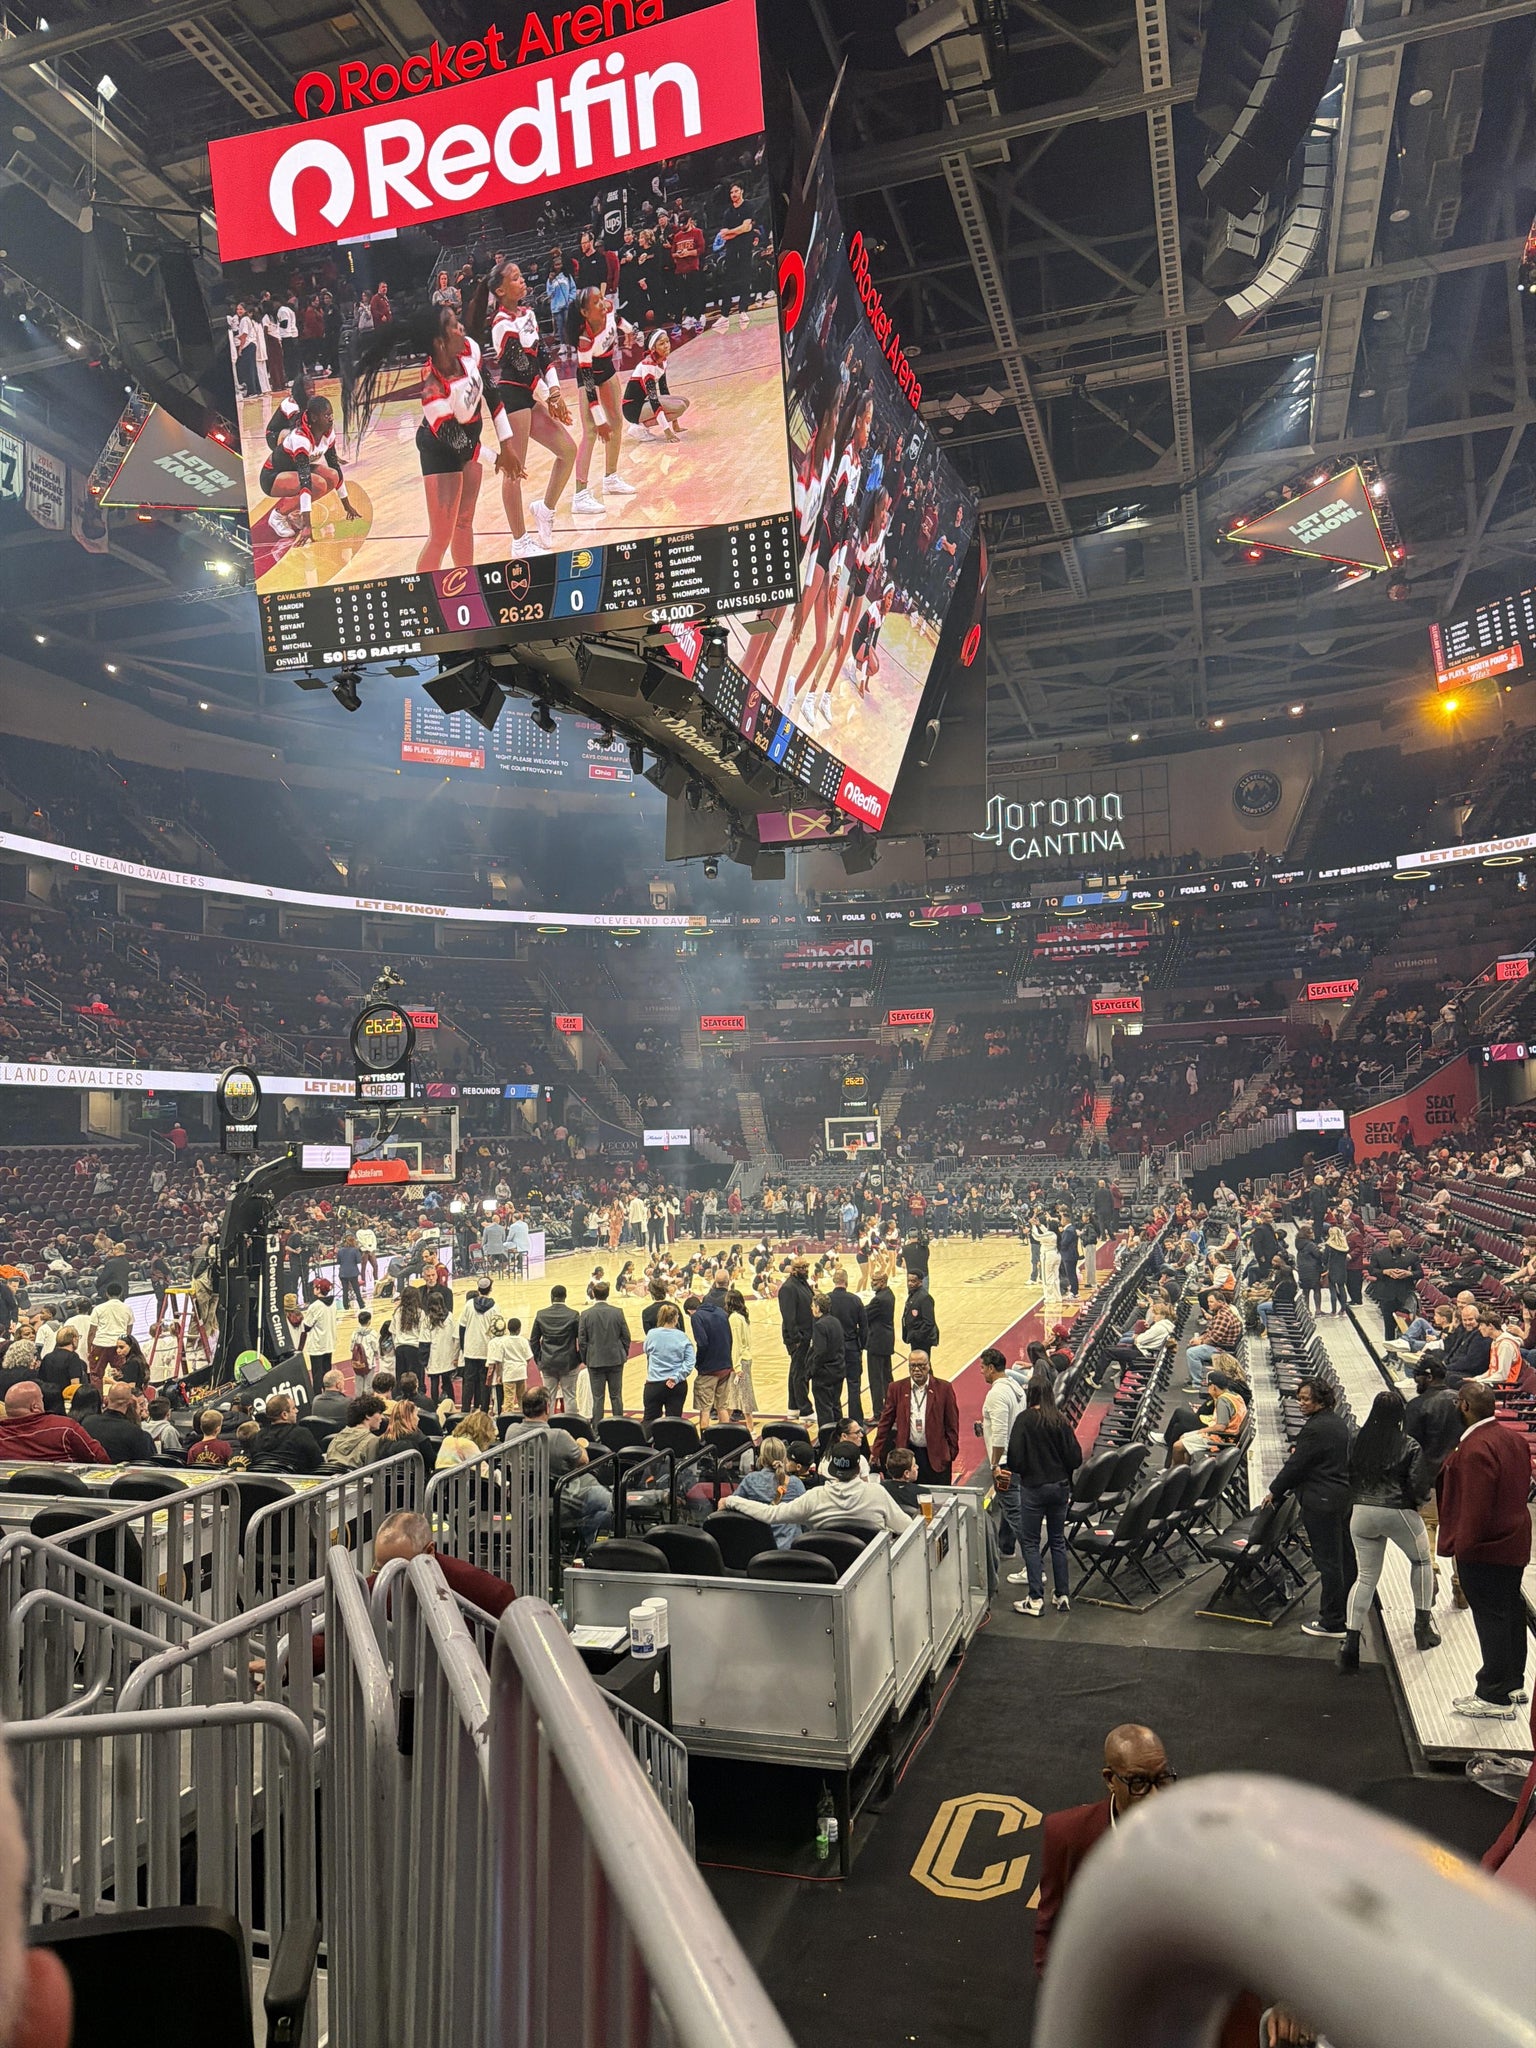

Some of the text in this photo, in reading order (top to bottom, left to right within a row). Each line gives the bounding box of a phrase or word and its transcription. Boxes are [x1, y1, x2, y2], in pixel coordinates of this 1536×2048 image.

[339, 0, 665, 111] Rocket Arena
[364, 51, 702, 220] Redfin
[606, 218, 621, 230] ups
[856, 248, 893, 351] Rocket
[886, 334, 922, 410] Arena
[31, 462, 60, 485] AMERICAN
[172, 450, 237, 488] LET EM
[28, 470, 64, 496] CONFERENCE
[152, 456, 221, 497] KNOW.
[30, 480, 62, 506] CHAMPIONS
[1288, 498, 1349, 536] LET EM
[668, 533, 694, 544] PACERS
[761, 518, 773, 526] AST
[1298, 508, 1364, 544] KNOW.
[616, 543, 638, 552] FOULS
[668, 545, 694, 556] POTTER
[669, 555, 702, 567] SLAWSON
[484, 570, 502, 585] 1Q
[670, 567, 696, 578] BROWN
[400, 576, 420, 584] FOULS
[672, 578, 702, 589] JACKSON
[276, 591, 311, 602] CAVALIERS
[570, 590, 584, 611] 0
[614, 590, 626, 598] 3PT
[672, 587, 710, 600] THOMPSON
[716, 588, 794, 610] CAVS5050.COM
[278, 602, 304, 612] HARDEN
[500, 603, 544, 624] 26:23
[651, 604, 694, 624] $4,000
[279, 613, 300, 622] STRUS
[400, 618, 412, 626] 3PT
[457, 605, 470, 626] 0
[280, 622, 305, 632] BRYANT
[281, 634, 298, 642] ELLIS
[282, 642, 312, 652] MITCHELL
[370, 642, 422, 658] RAFFLE
[276, 652, 308, 666] oswald
[1466, 660, 1490, 674] SMOOTH
[1490, 653, 1508, 666] POURS
[746, 716, 752, 732] 0
[754, 731, 770, 752] 26:23
[404, 744, 413, 752] BIG
[433, 748, 454, 757] SMOOTH
[455, 750, 472, 758] POURS
[774, 743, 780, 758] 0
[534, 758, 560, 766] WELCOME
[852, 785, 882, 818] Redfin
[968, 792, 1126, 845] Corona
[1010, 828, 1126, 862] CANTINA
[1420, 838, 1533, 863] LET EM KNOW.
[70, 850, 206, 888] CLEVELAND CAVALIERS
[1318, 862, 1392, 879] LET EM KNOW.
[1132, 878, 1260, 900] FG% 0 FOULS 0 TOL 7
[1011, 898, 1058, 910] 26:23 1Q
[1076, 896, 1082, 904] 0
[355, 900, 450, 918] LET EM KNOW.
[842, 914, 866, 922] FOULS
[870, 912, 876, 920] 0
[909, 910, 914, 918] 0
[962, 905, 968, 914] 0
[594, 915, 658, 925] CLEVELAND
[1310, 983, 1356, 996] SEATGEEK
[1094, 1001, 1140, 1012] SEATGEEK
[703, 1017, 743, 1028] SEATGEEK
[892, 1010, 932, 1023] SEATGEEK
[366, 1018, 402, 1035] 26:23
[1516, 1045, 1524, 1057] 0
[4, 1064, 144, 1086] LAND CAVALIERS
[371, 1072, 406, 1082] TISSOT
[844, 1077, 864, 1086] 26:23
[304, 1081, 328, 1092] LET
[330, 1082, 346, 1092] EM
[450, 1086, 456, 1096] 0
[510, 1088, 516, 1096] 0
[1426, 1094, 1456, 1109] SEAT
[1424, 1110, 1458, 1125] GEEK
[1366, 1122, 1396, 1133] SEAT
[1364, 1133, 1398, 1144] GEEK
[269, 1254, 286, 1348] Cleveland Clinic
